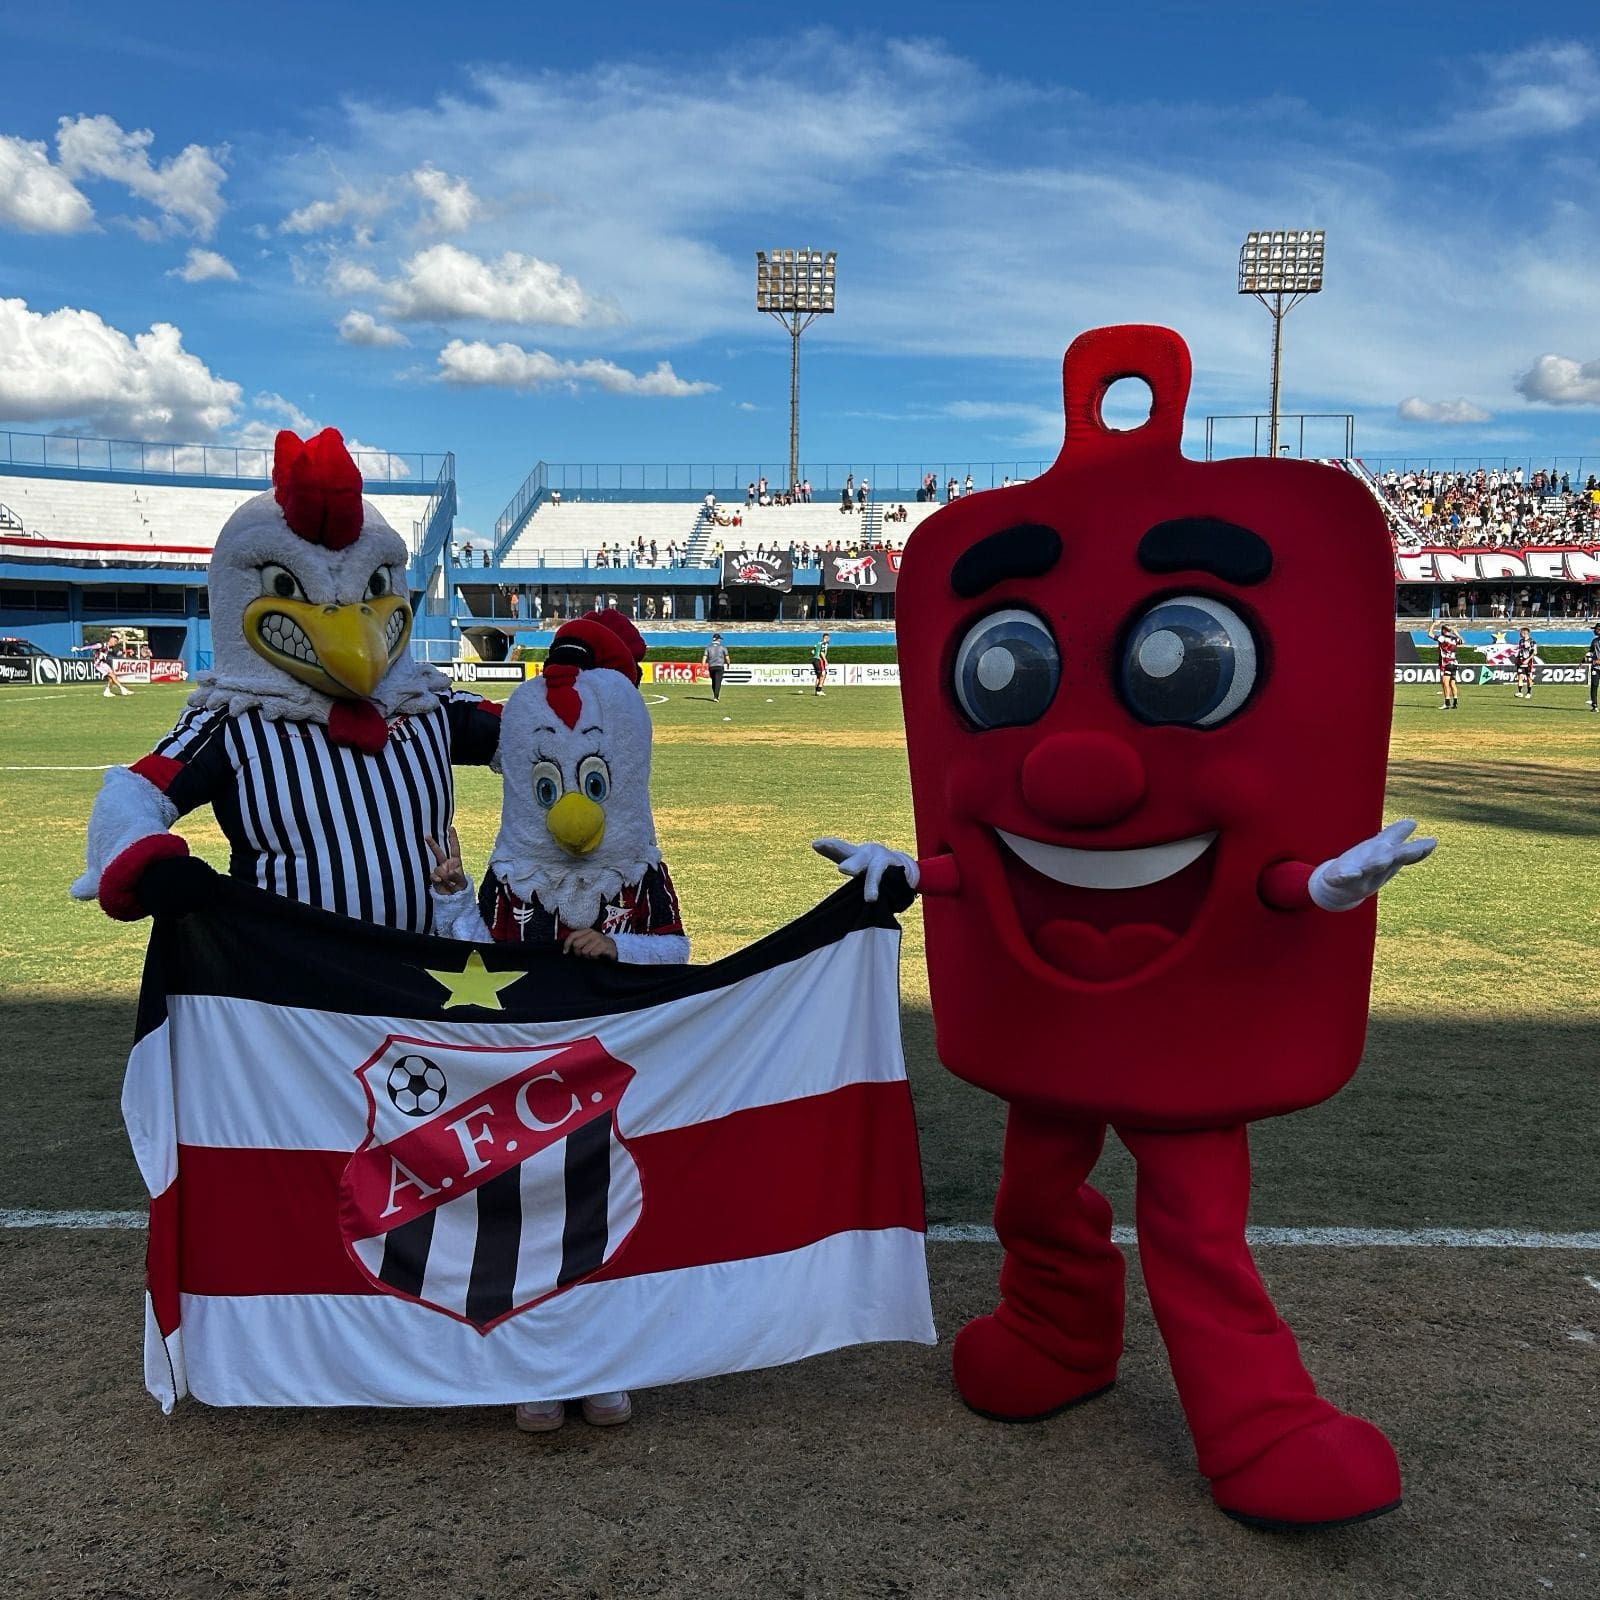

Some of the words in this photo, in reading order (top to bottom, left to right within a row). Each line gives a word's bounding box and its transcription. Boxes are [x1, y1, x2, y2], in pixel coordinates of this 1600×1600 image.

[655, 664, 693, 680] Fricó
[1541, 668, 1586, 682] 2025
[379, 1070, 603, 1220] A.F.C.
